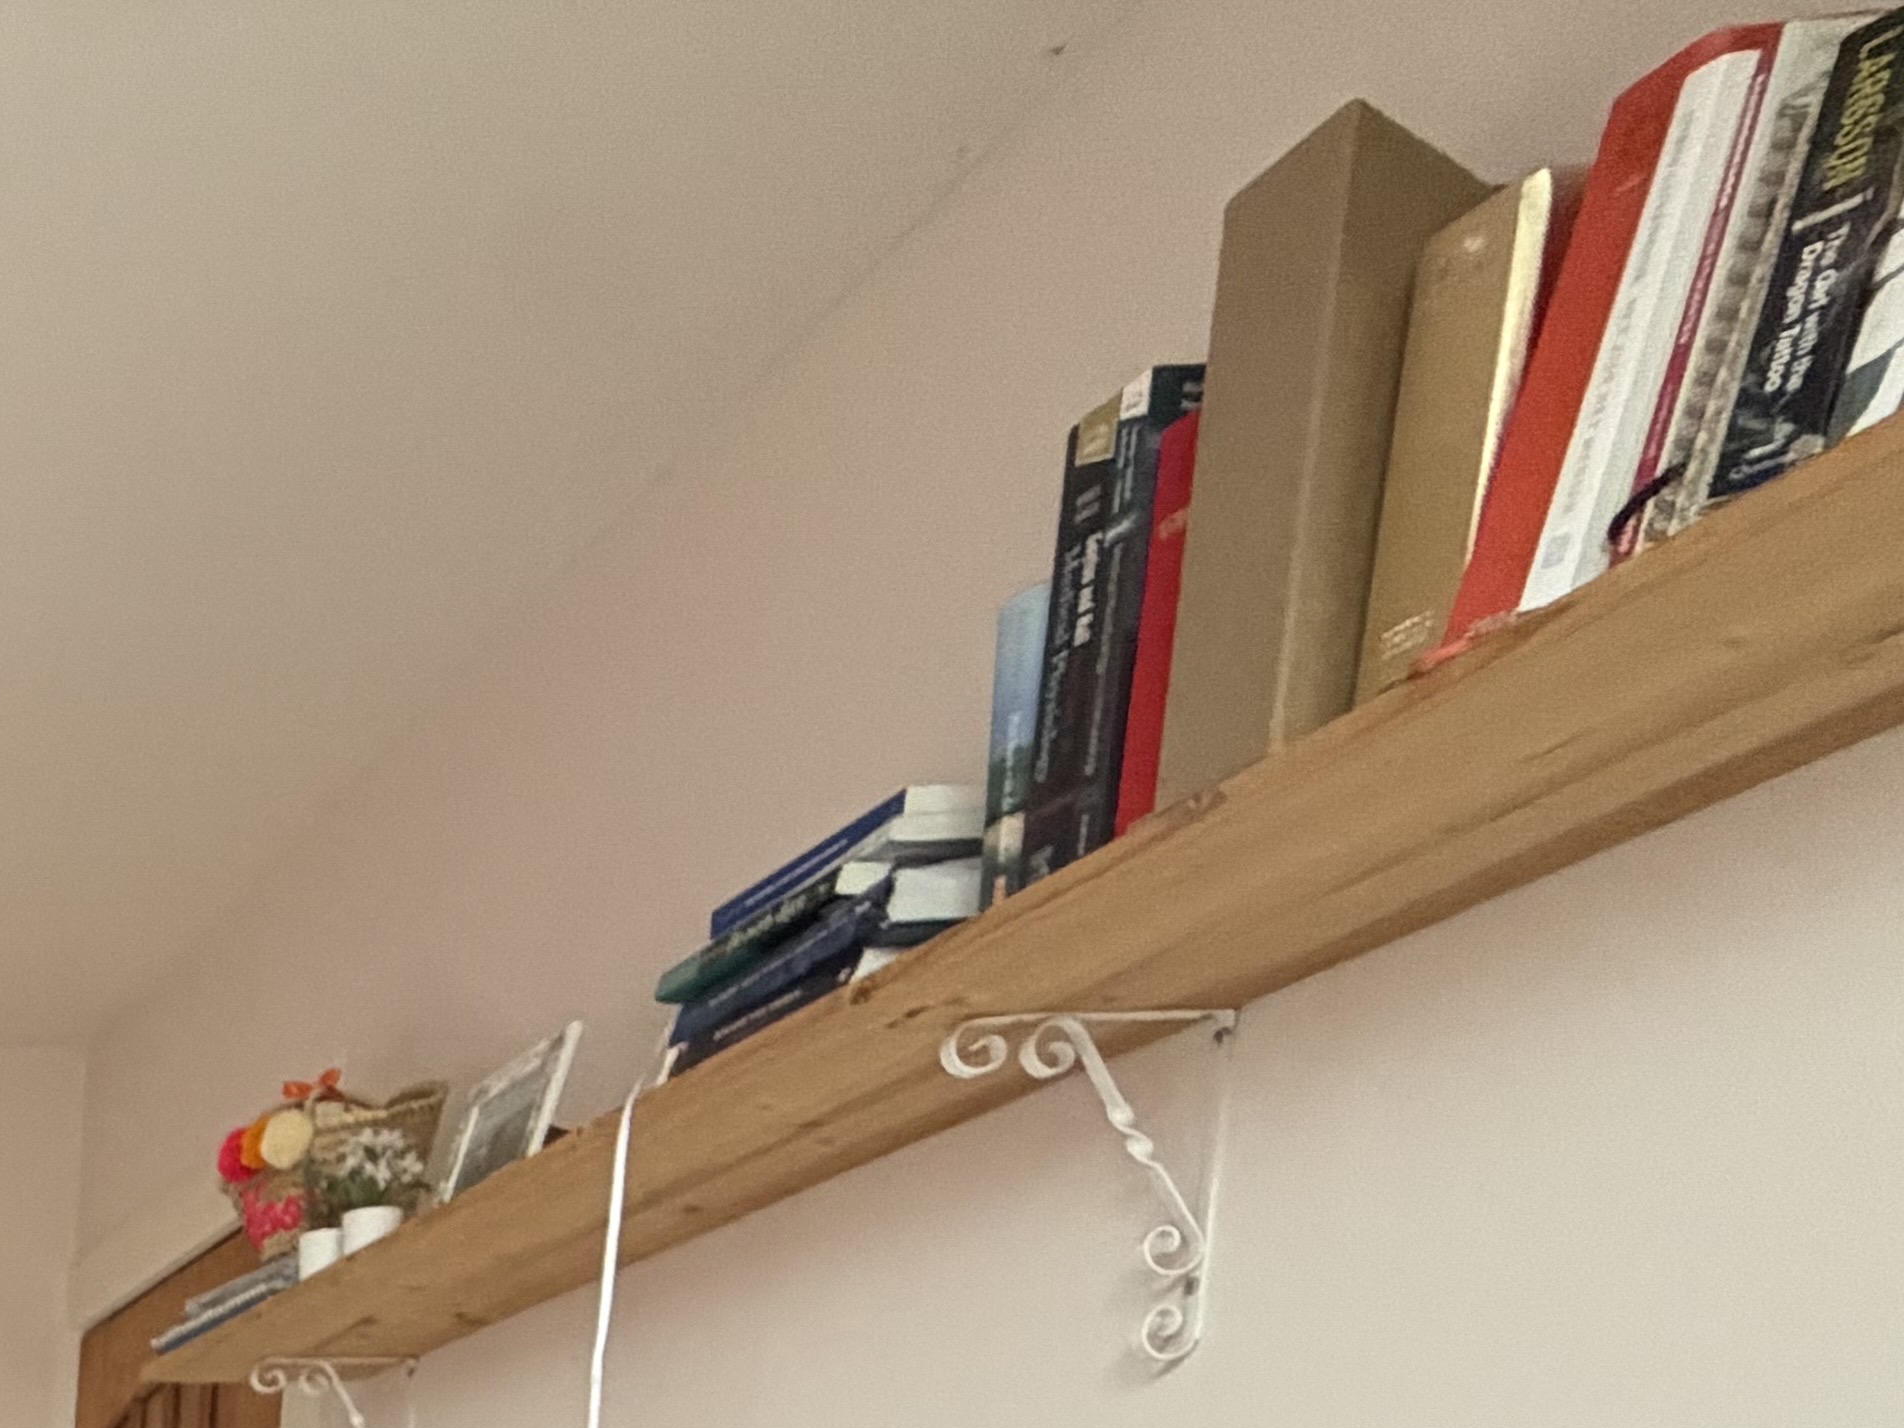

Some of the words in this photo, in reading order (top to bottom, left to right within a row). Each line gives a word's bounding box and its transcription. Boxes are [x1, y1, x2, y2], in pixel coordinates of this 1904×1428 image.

[1822, 25, 1904, 191] LARSSON
[1820, 221, 1852, 267] The
[1782, 240, 1825, 324] Dragon
[1807, 269, 1839, 310] Girl
[1795, 310, 1821, 356] with
[1763, 322, 1803, 393] Tattoo
[1785, 354, 1815, 392] the
